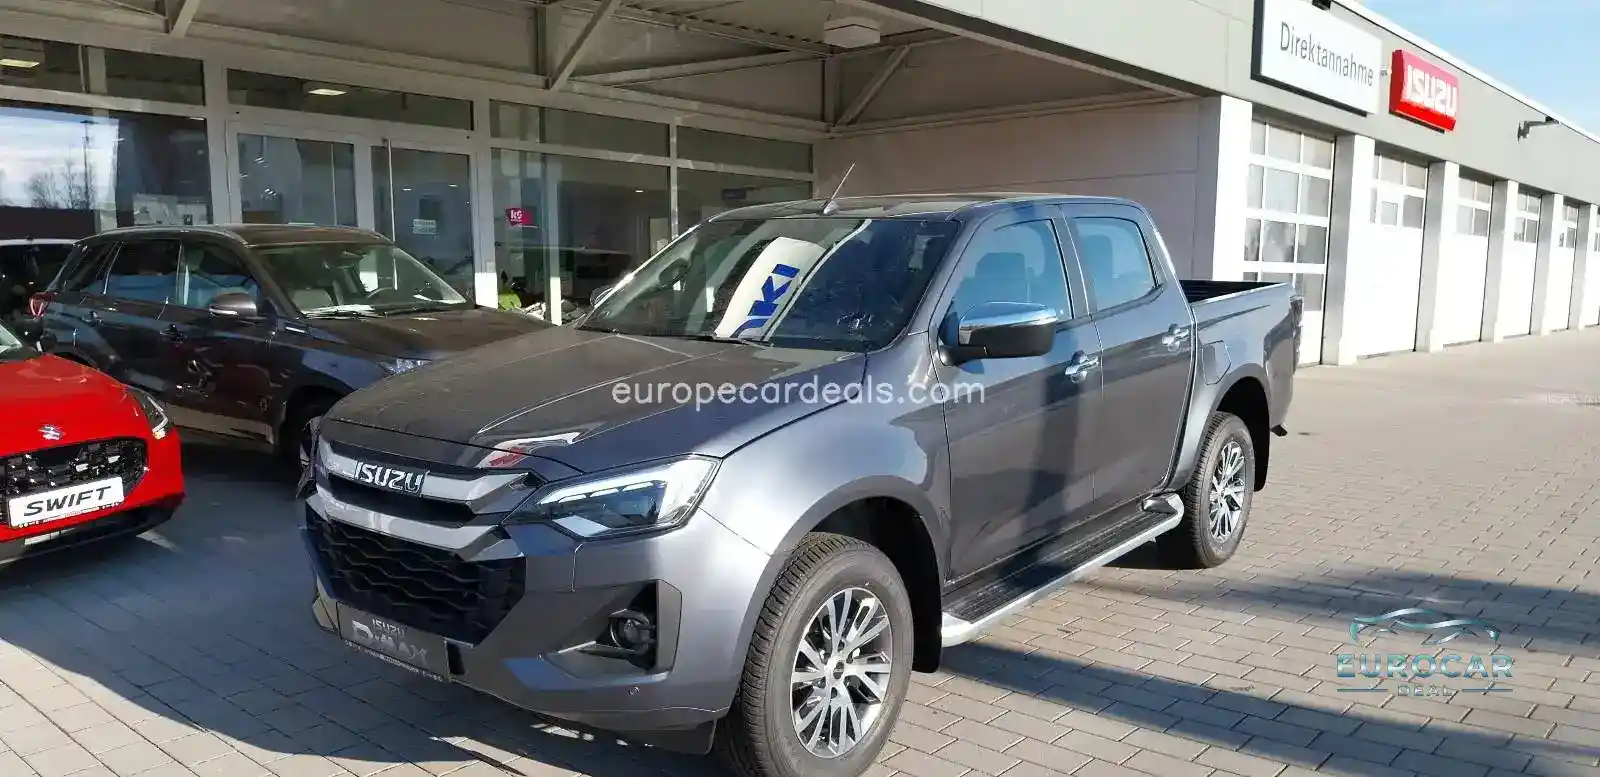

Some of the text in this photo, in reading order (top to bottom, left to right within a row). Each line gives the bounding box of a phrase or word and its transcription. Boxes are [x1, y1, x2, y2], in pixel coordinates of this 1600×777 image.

[1280, 21, 1374, 86] Direktannahme
[1407, 64, 1457, 118] ISUZU
[354, 461, 424, 493] ISUZU
[23, 486, 111, 517] SWIFT
